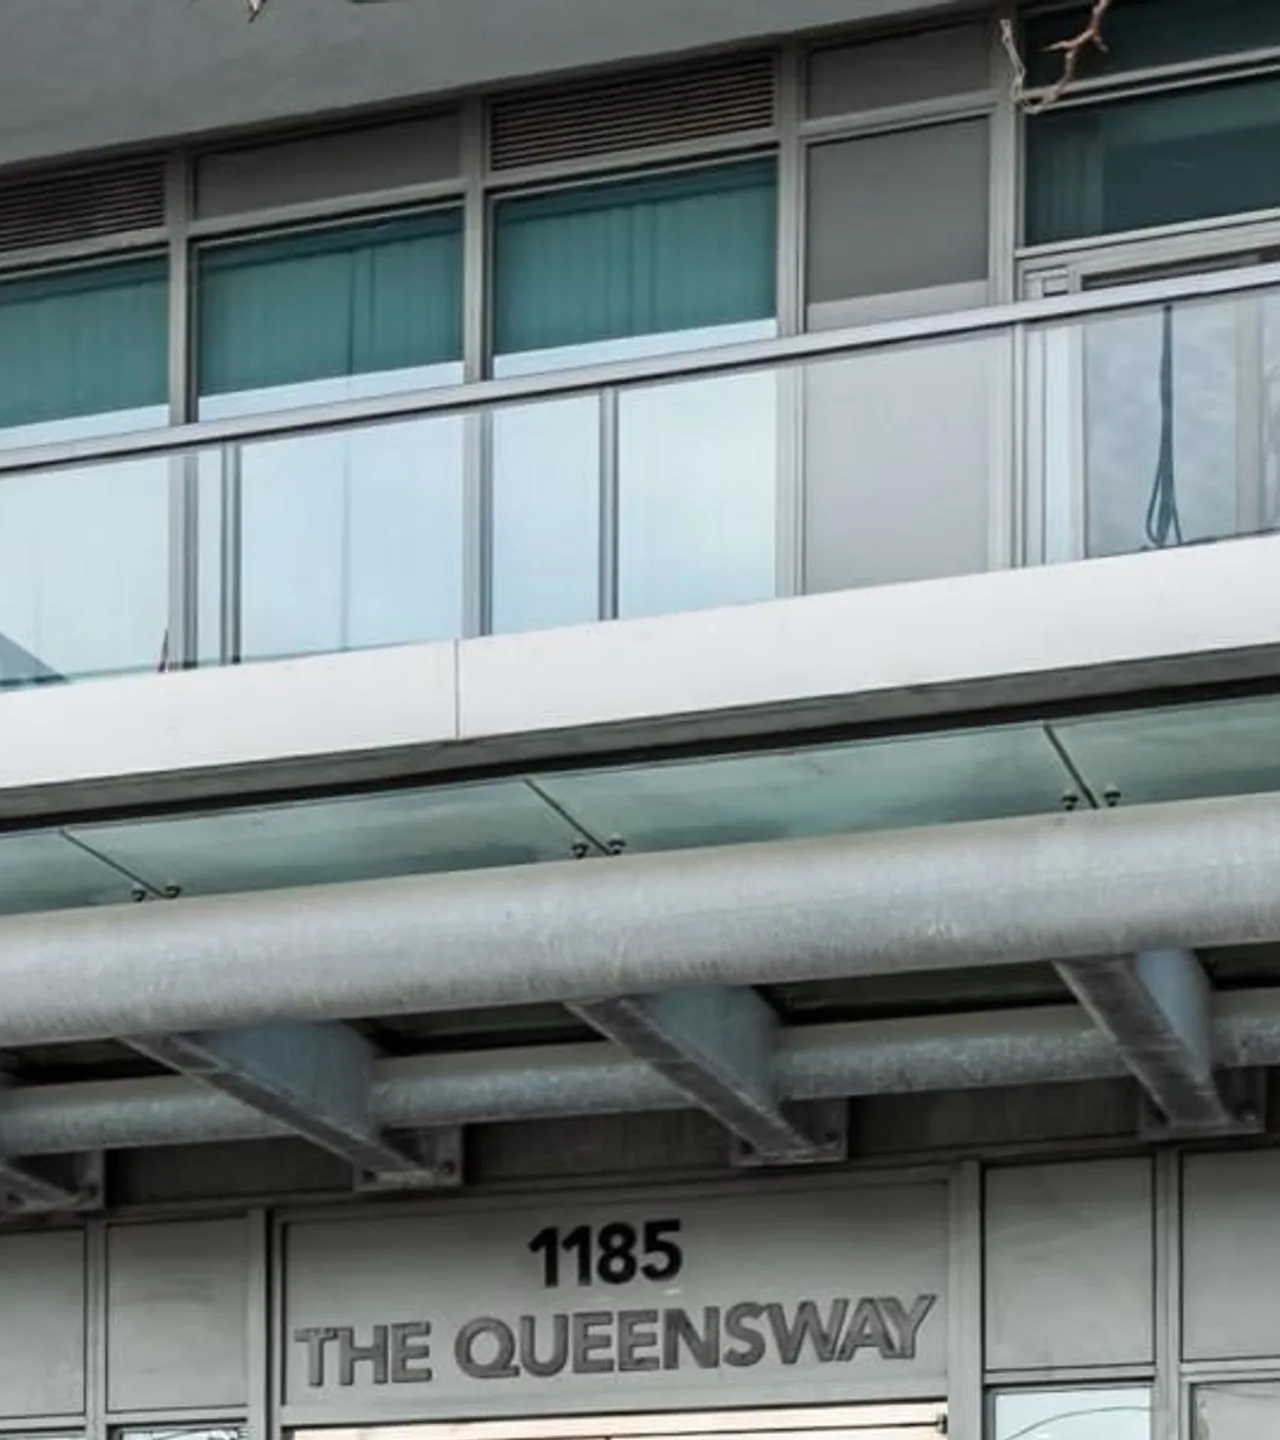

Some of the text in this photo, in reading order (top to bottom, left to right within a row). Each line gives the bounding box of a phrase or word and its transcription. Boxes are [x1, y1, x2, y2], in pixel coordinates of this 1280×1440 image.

[528, 1219, 682, 1287] 1185
[295, 1294, 937, 1387] THE QUEENSWAY
